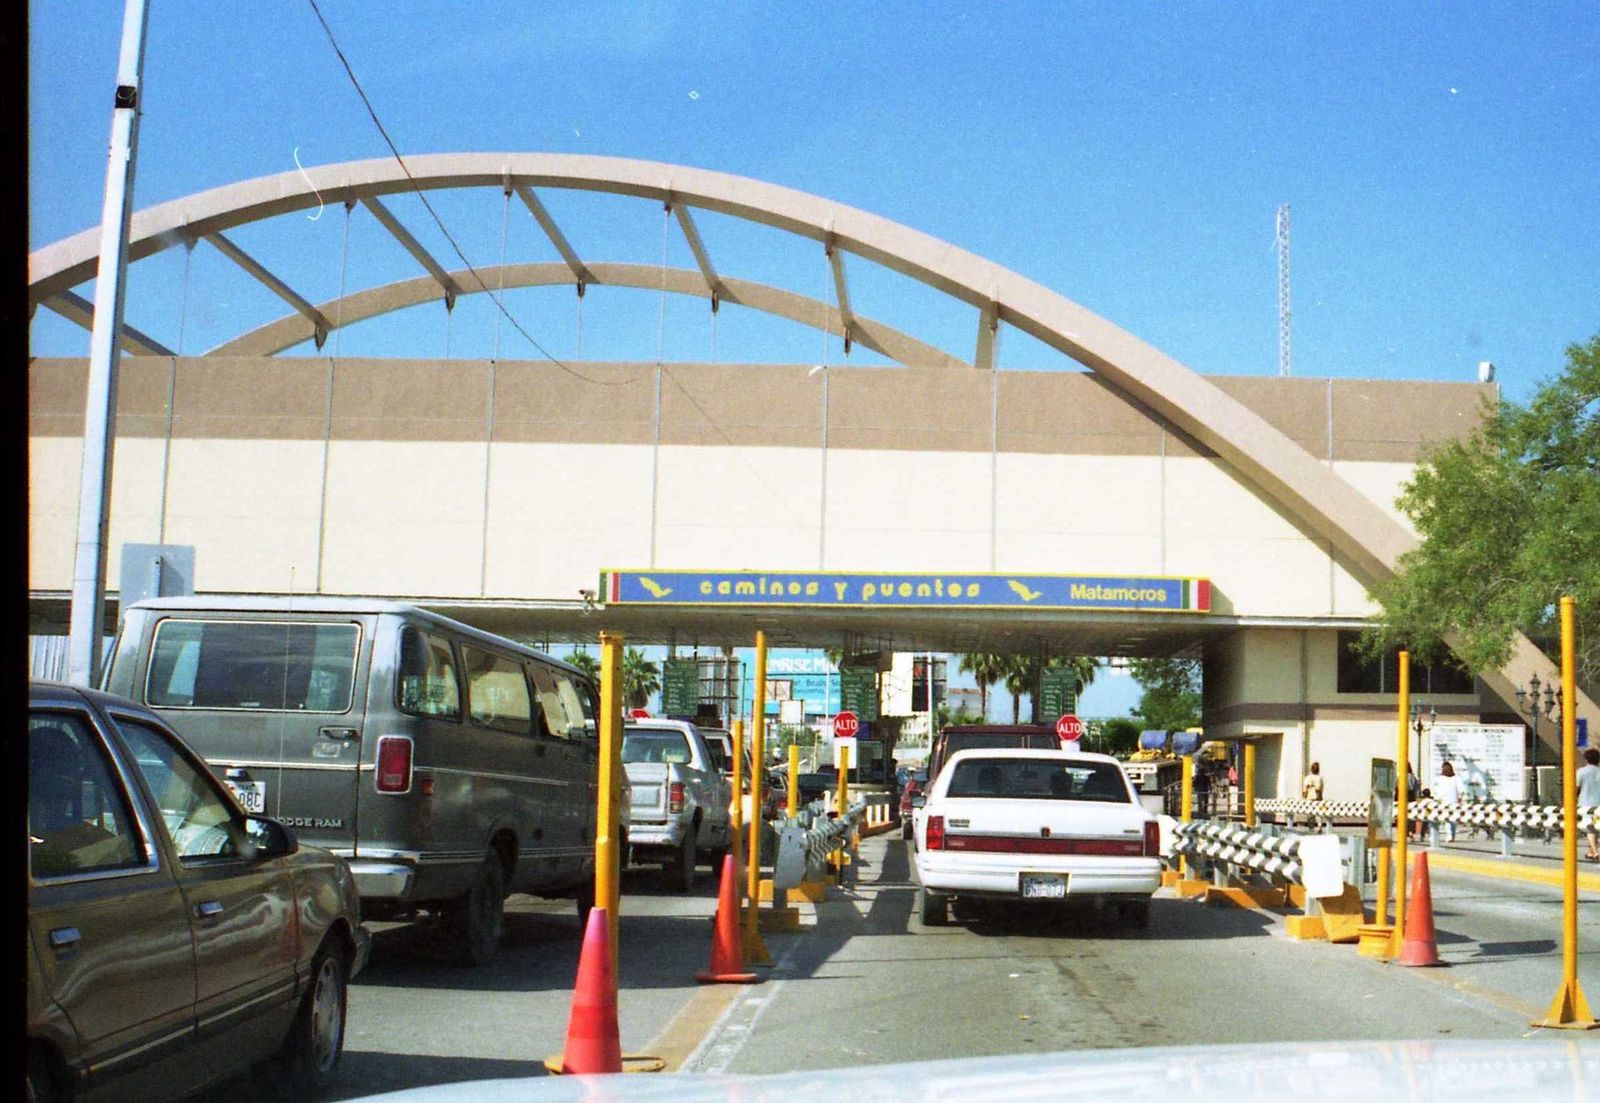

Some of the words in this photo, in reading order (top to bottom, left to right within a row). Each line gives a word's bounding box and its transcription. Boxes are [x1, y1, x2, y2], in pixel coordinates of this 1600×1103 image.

[700, 577, 819, 595] caminos
[862, 578, 981, 600] puentes
[1070, 583, 1167, 602] Matamoros
[834, 719, 857, 730] ALTO
[1058, 722, 1081, 734] ALTO
[314, 817, 342, 828] RAM
